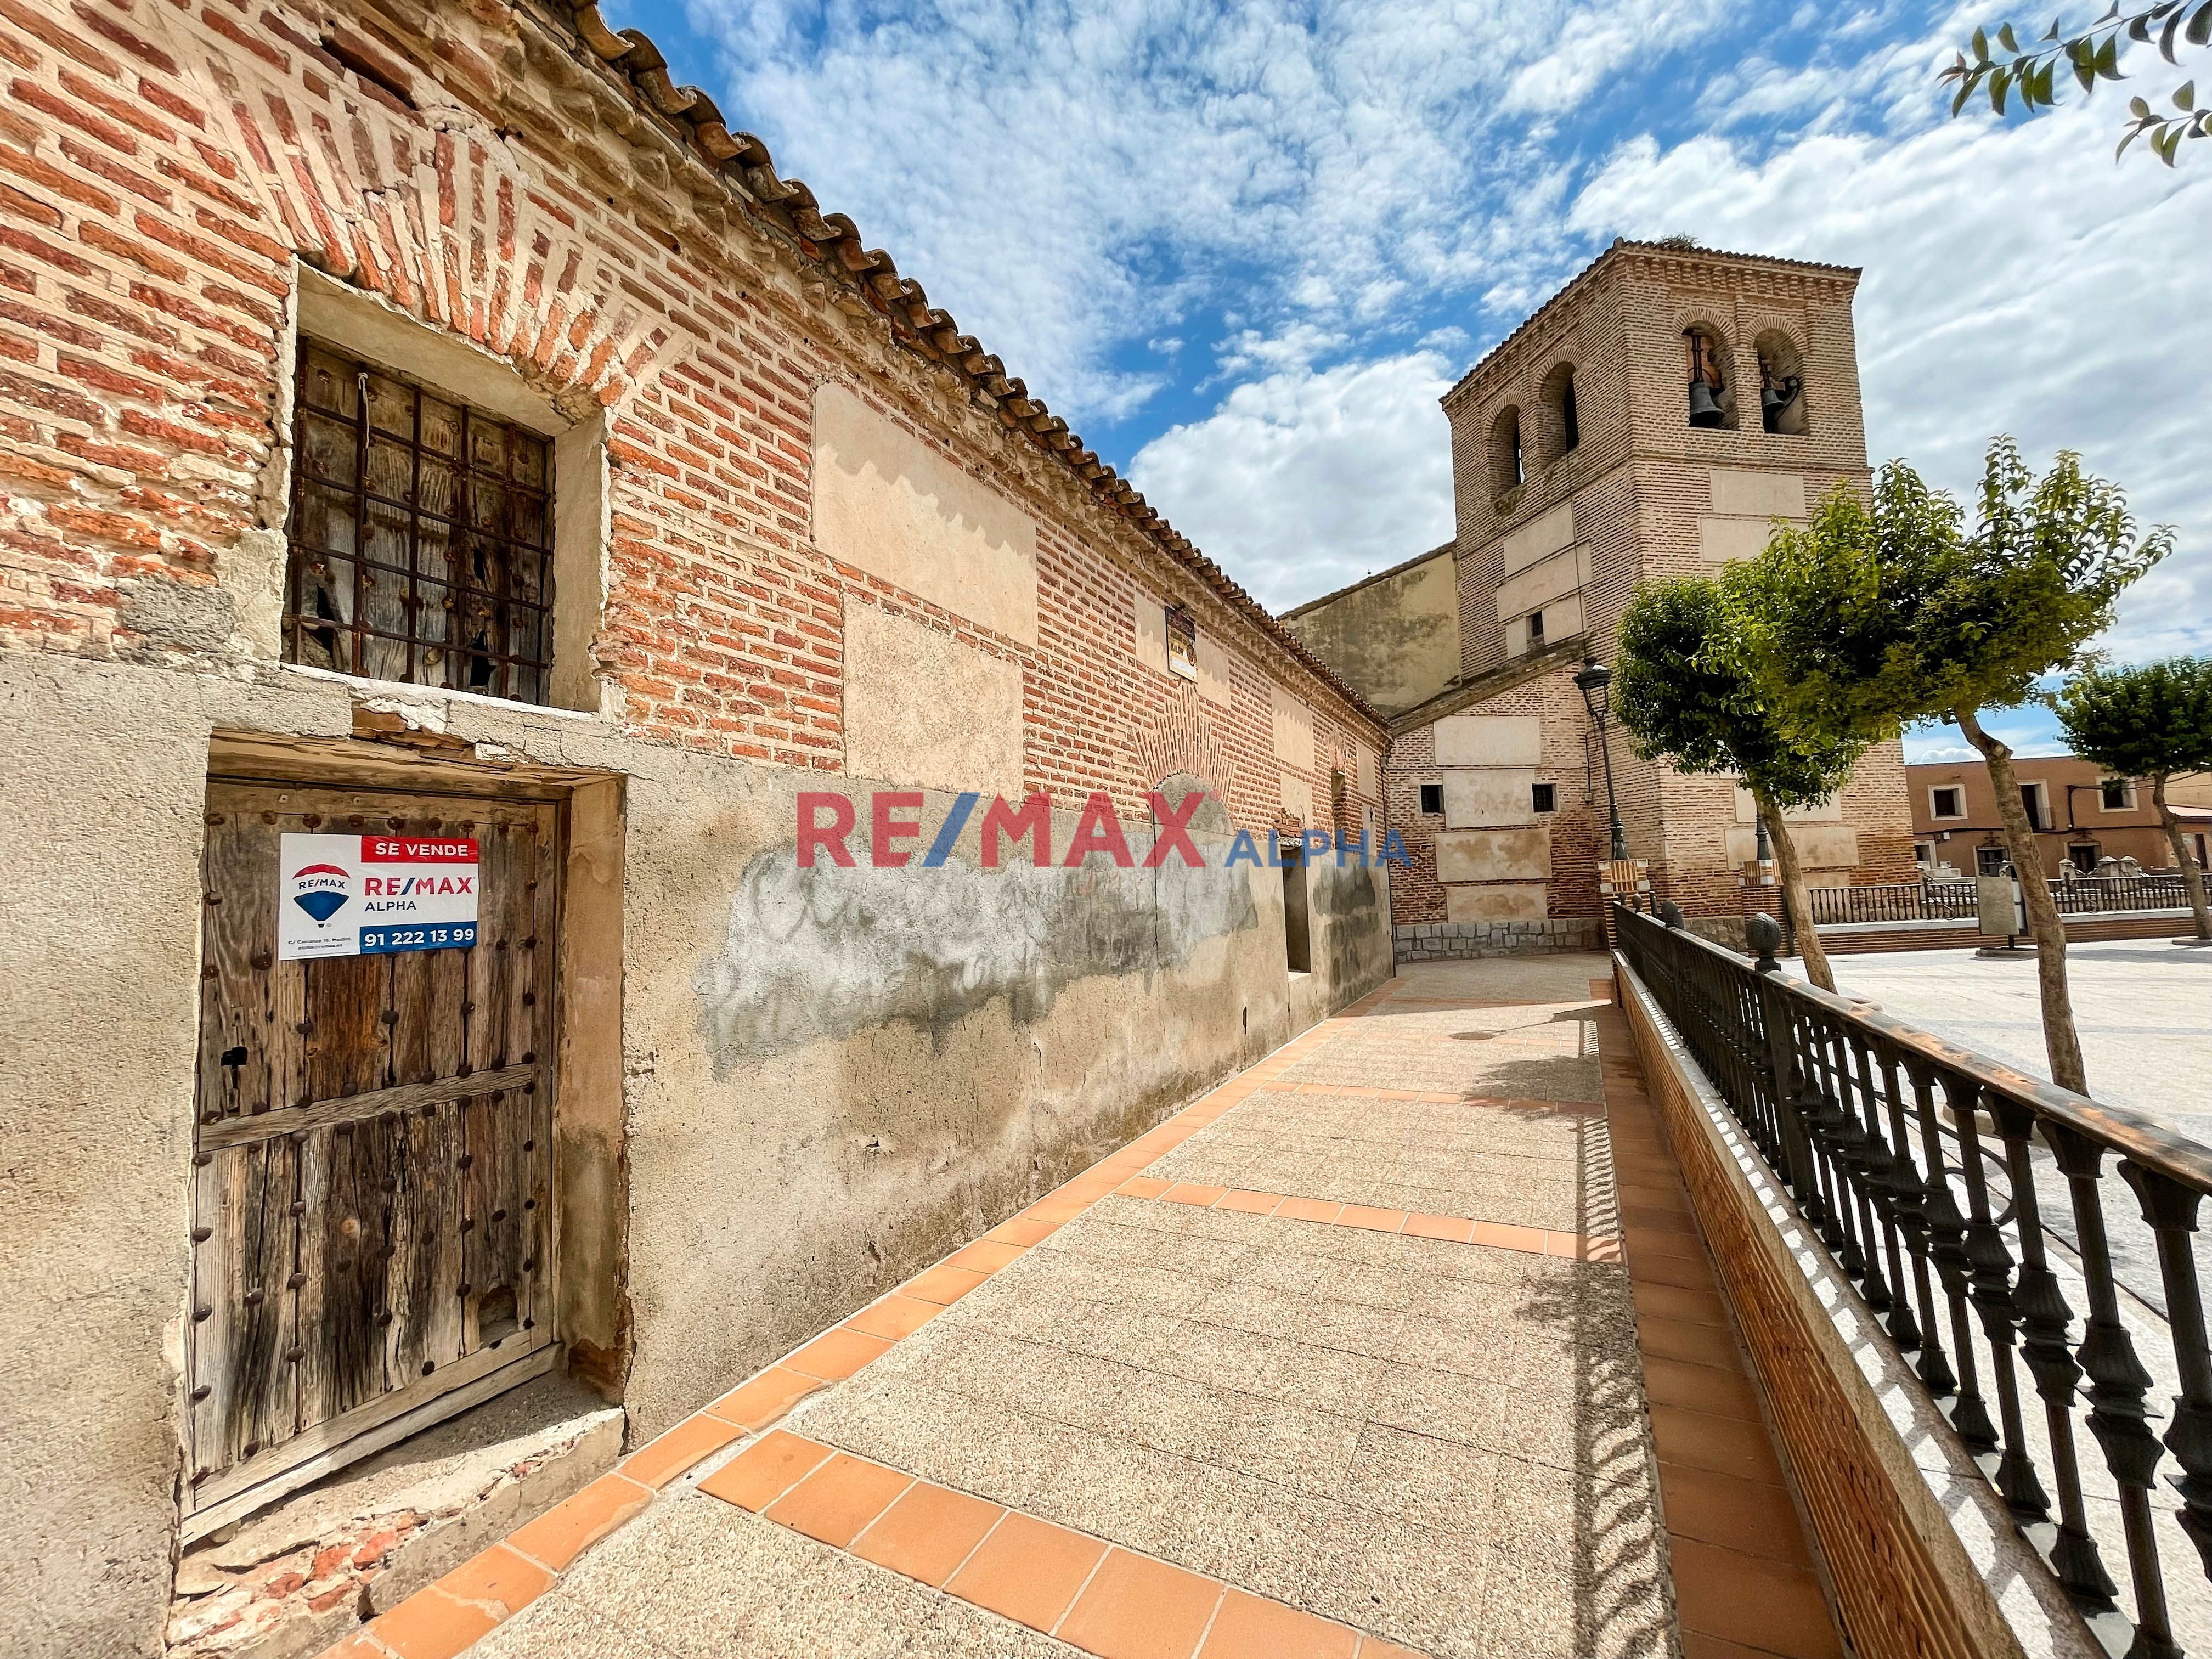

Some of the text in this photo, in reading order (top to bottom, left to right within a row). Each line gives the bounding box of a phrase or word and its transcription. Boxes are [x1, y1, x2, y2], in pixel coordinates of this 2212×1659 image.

[375, 843, 469, 856] SE VENDE
[298, 879, 346, 890] RE/MAX
[365, 877, 473, 896] RE/MAX
[364, 901, 417, 912] ALPHA
[364, 928, 475, 947] 91 222 13 99
